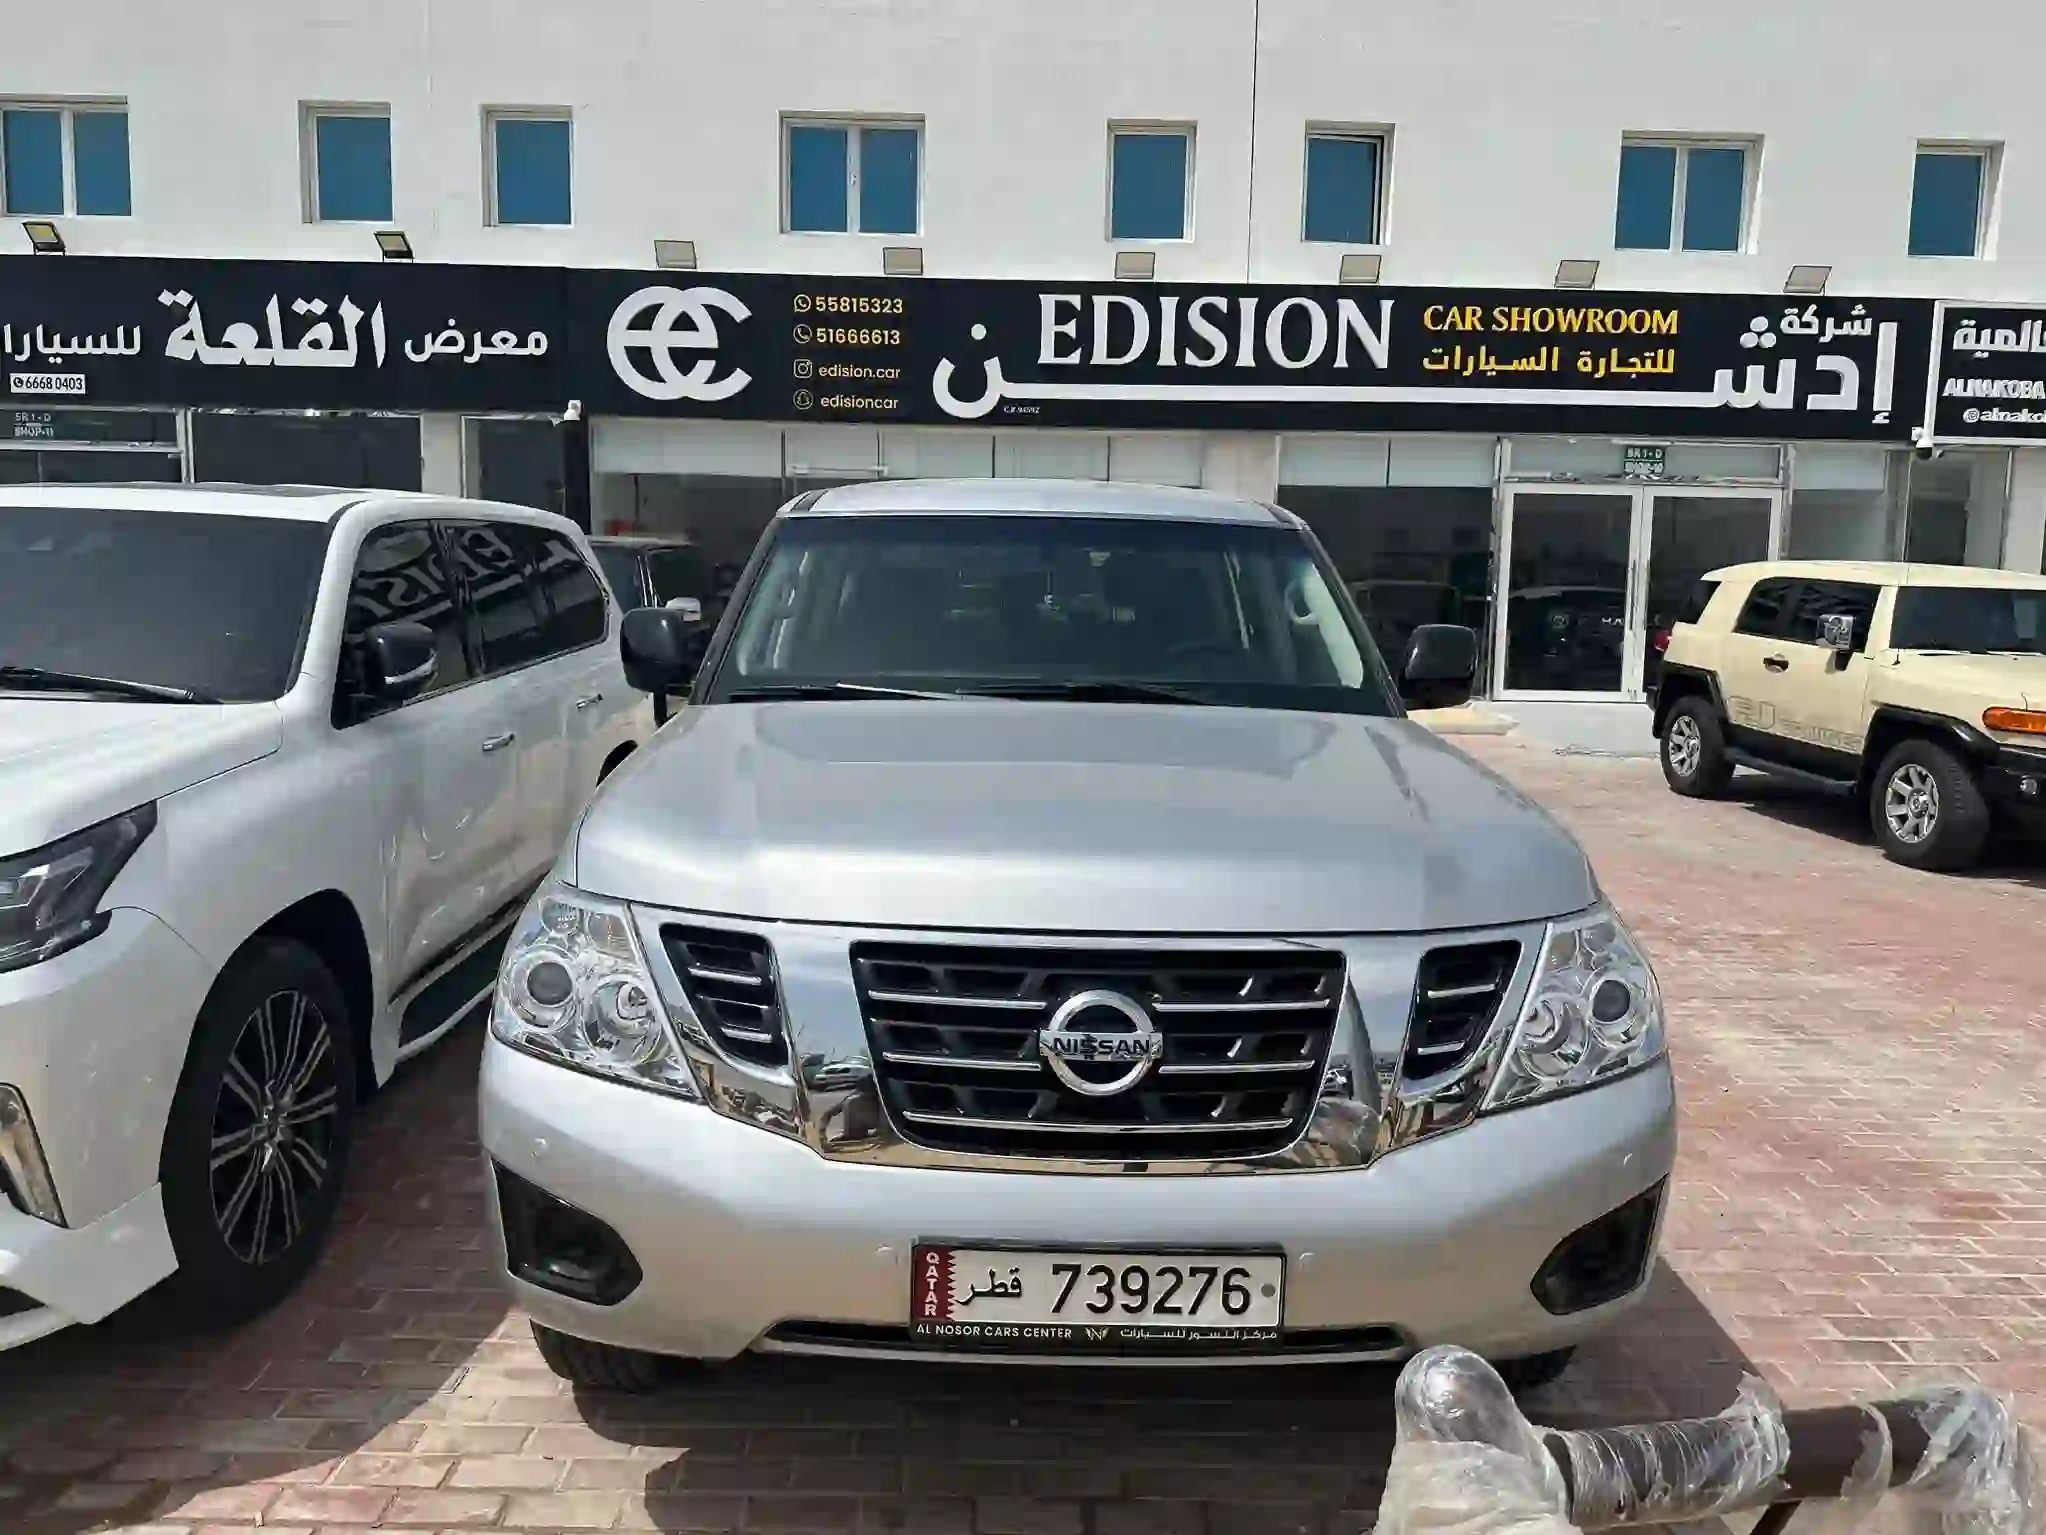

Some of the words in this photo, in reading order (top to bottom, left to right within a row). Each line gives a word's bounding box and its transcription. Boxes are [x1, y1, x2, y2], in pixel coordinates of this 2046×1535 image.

[814, 296, 904, 315] 55815323
[1422, 304, 1486, 332] CAR
[1490, 305, 1680, 335] SHOWROOM
[157, 288, 386, 369] القلعة
[815, 327, 901, 346] 51666613
[1036, 292, 1396, 371] EDISION
[1779, 303, 1874, 341] شركة
[3, 323, 141, 365] للسيارا
[404, 318, 548, 364] معرض
[817, 363, 902, 381] edision.car
[1421, 345, 1560, 378] السيارات
[1576, 347, 1676, 378] للتجارة
[25, 376, 53, 390] 6668
[54, 377, 83, 391] 0403
[819, 393, 900, 410] edisioncar
[1052, 1036, 1152, 1056] NISSAN
[924, 1251, 941, 1317] QATAR
[956, 1267, 1022, 1305] قطر
[1050, 1263, 1252, 1316] 739276
[916, 1324, 931, 1335] AL
[935, 1324, 981, 1337] NOSOR
[984, 1326, 1020, 1338] CARS
[1023, 1327, 1073, 1340] CENTER
